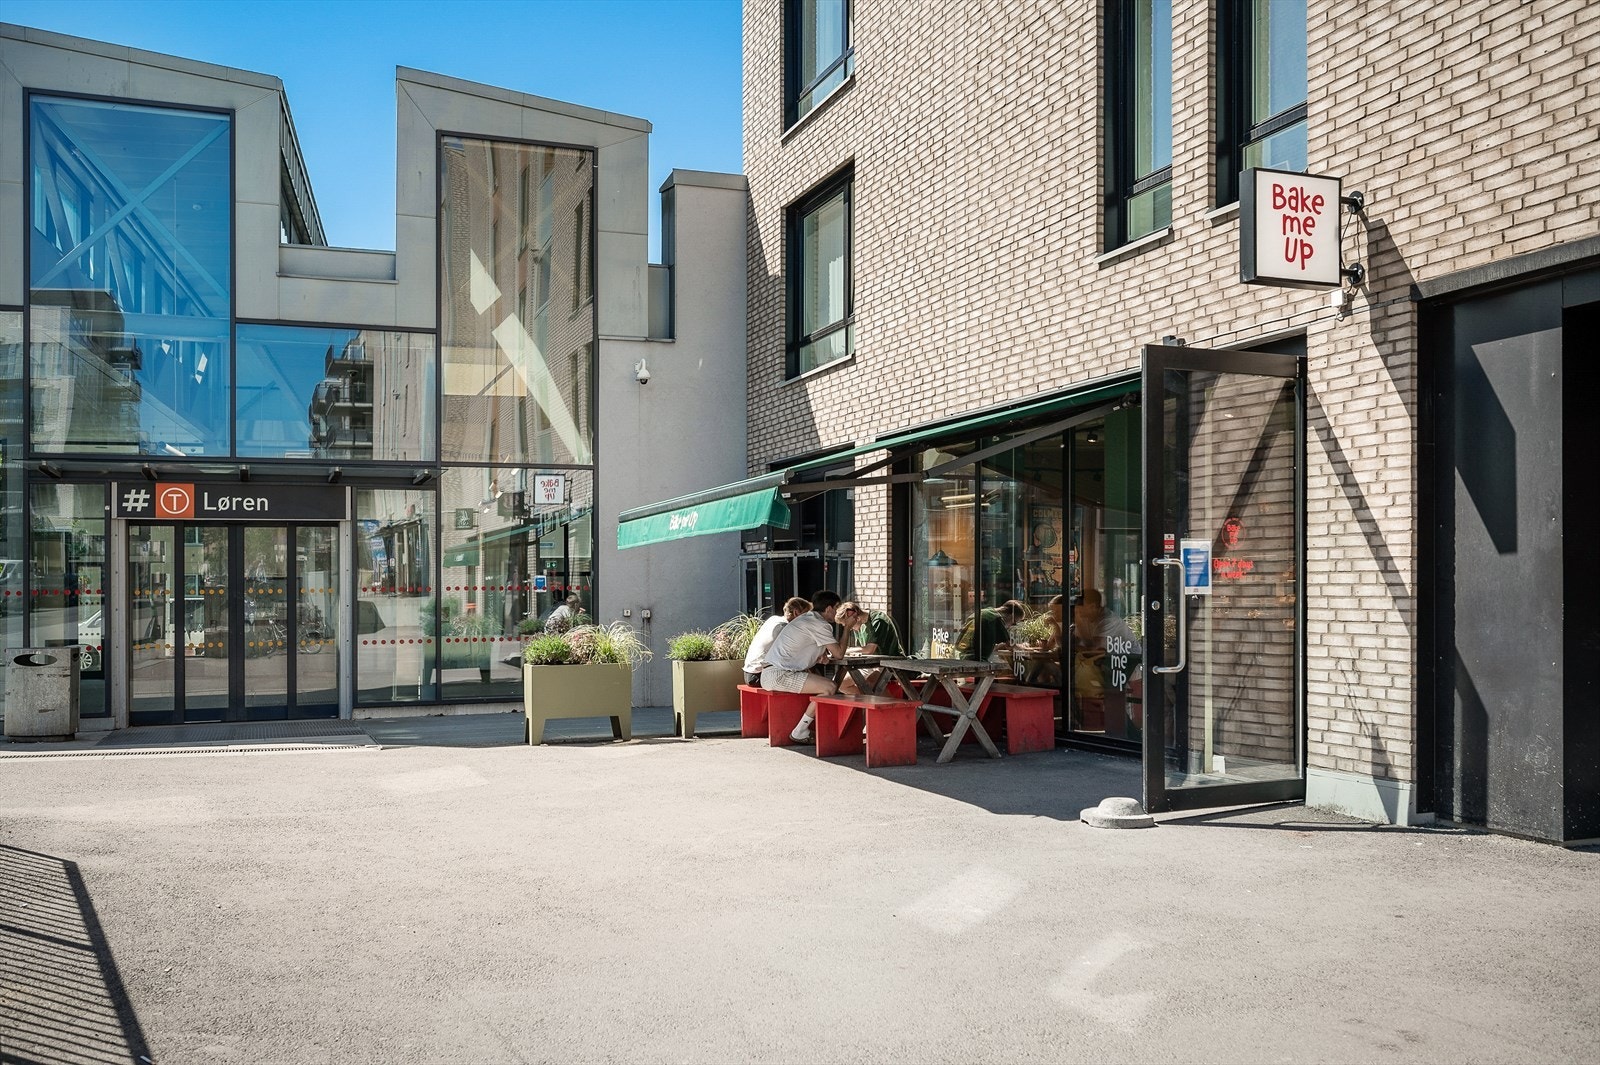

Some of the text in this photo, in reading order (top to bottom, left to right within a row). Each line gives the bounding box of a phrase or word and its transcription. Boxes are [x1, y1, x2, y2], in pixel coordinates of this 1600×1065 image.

[1272, 183, 1325, 215] Bake
[1282, 213, 1316, 237] me
[203, 492, 269, 511] Løren
[932, 627, 949, 643] Bake
[1106, 635, 1132, 655] Bake
[1111, 654, 1128, 670] me
